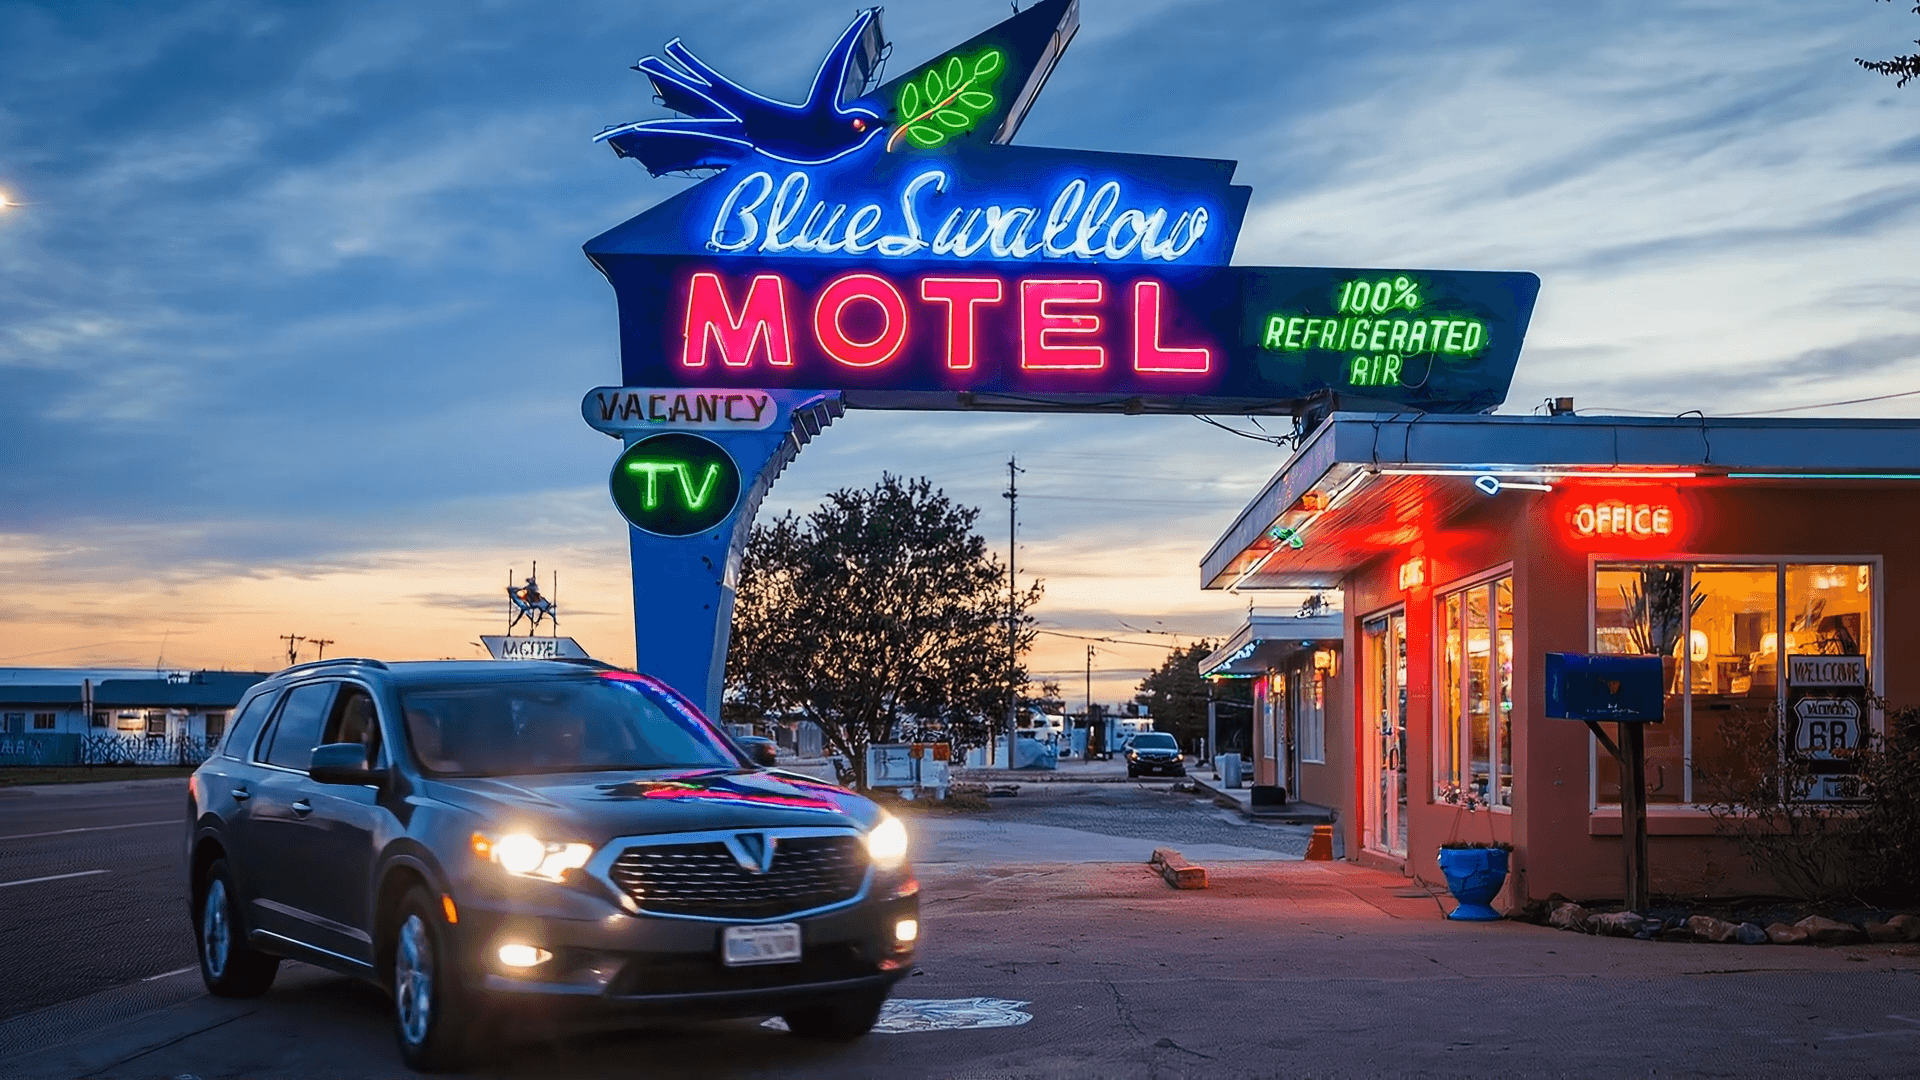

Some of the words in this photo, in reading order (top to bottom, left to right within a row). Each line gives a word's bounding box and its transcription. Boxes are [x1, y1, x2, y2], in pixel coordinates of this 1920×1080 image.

[705, 171, 882, 254] Blue
[878, 170, 1209, 261] Swallow
[1339, 276, 1418, 314] 100%
[682, 273, 1211, 373] MOTEL
[1264, 316, 1483, 353] REFRIGERATED
[1350, 354, 1401, 386] AIR
[597, 392, 768, 422] VACANCY
[627, 461, 720, 509] TV
[1576, 506, 1670, 534] OFFICE
